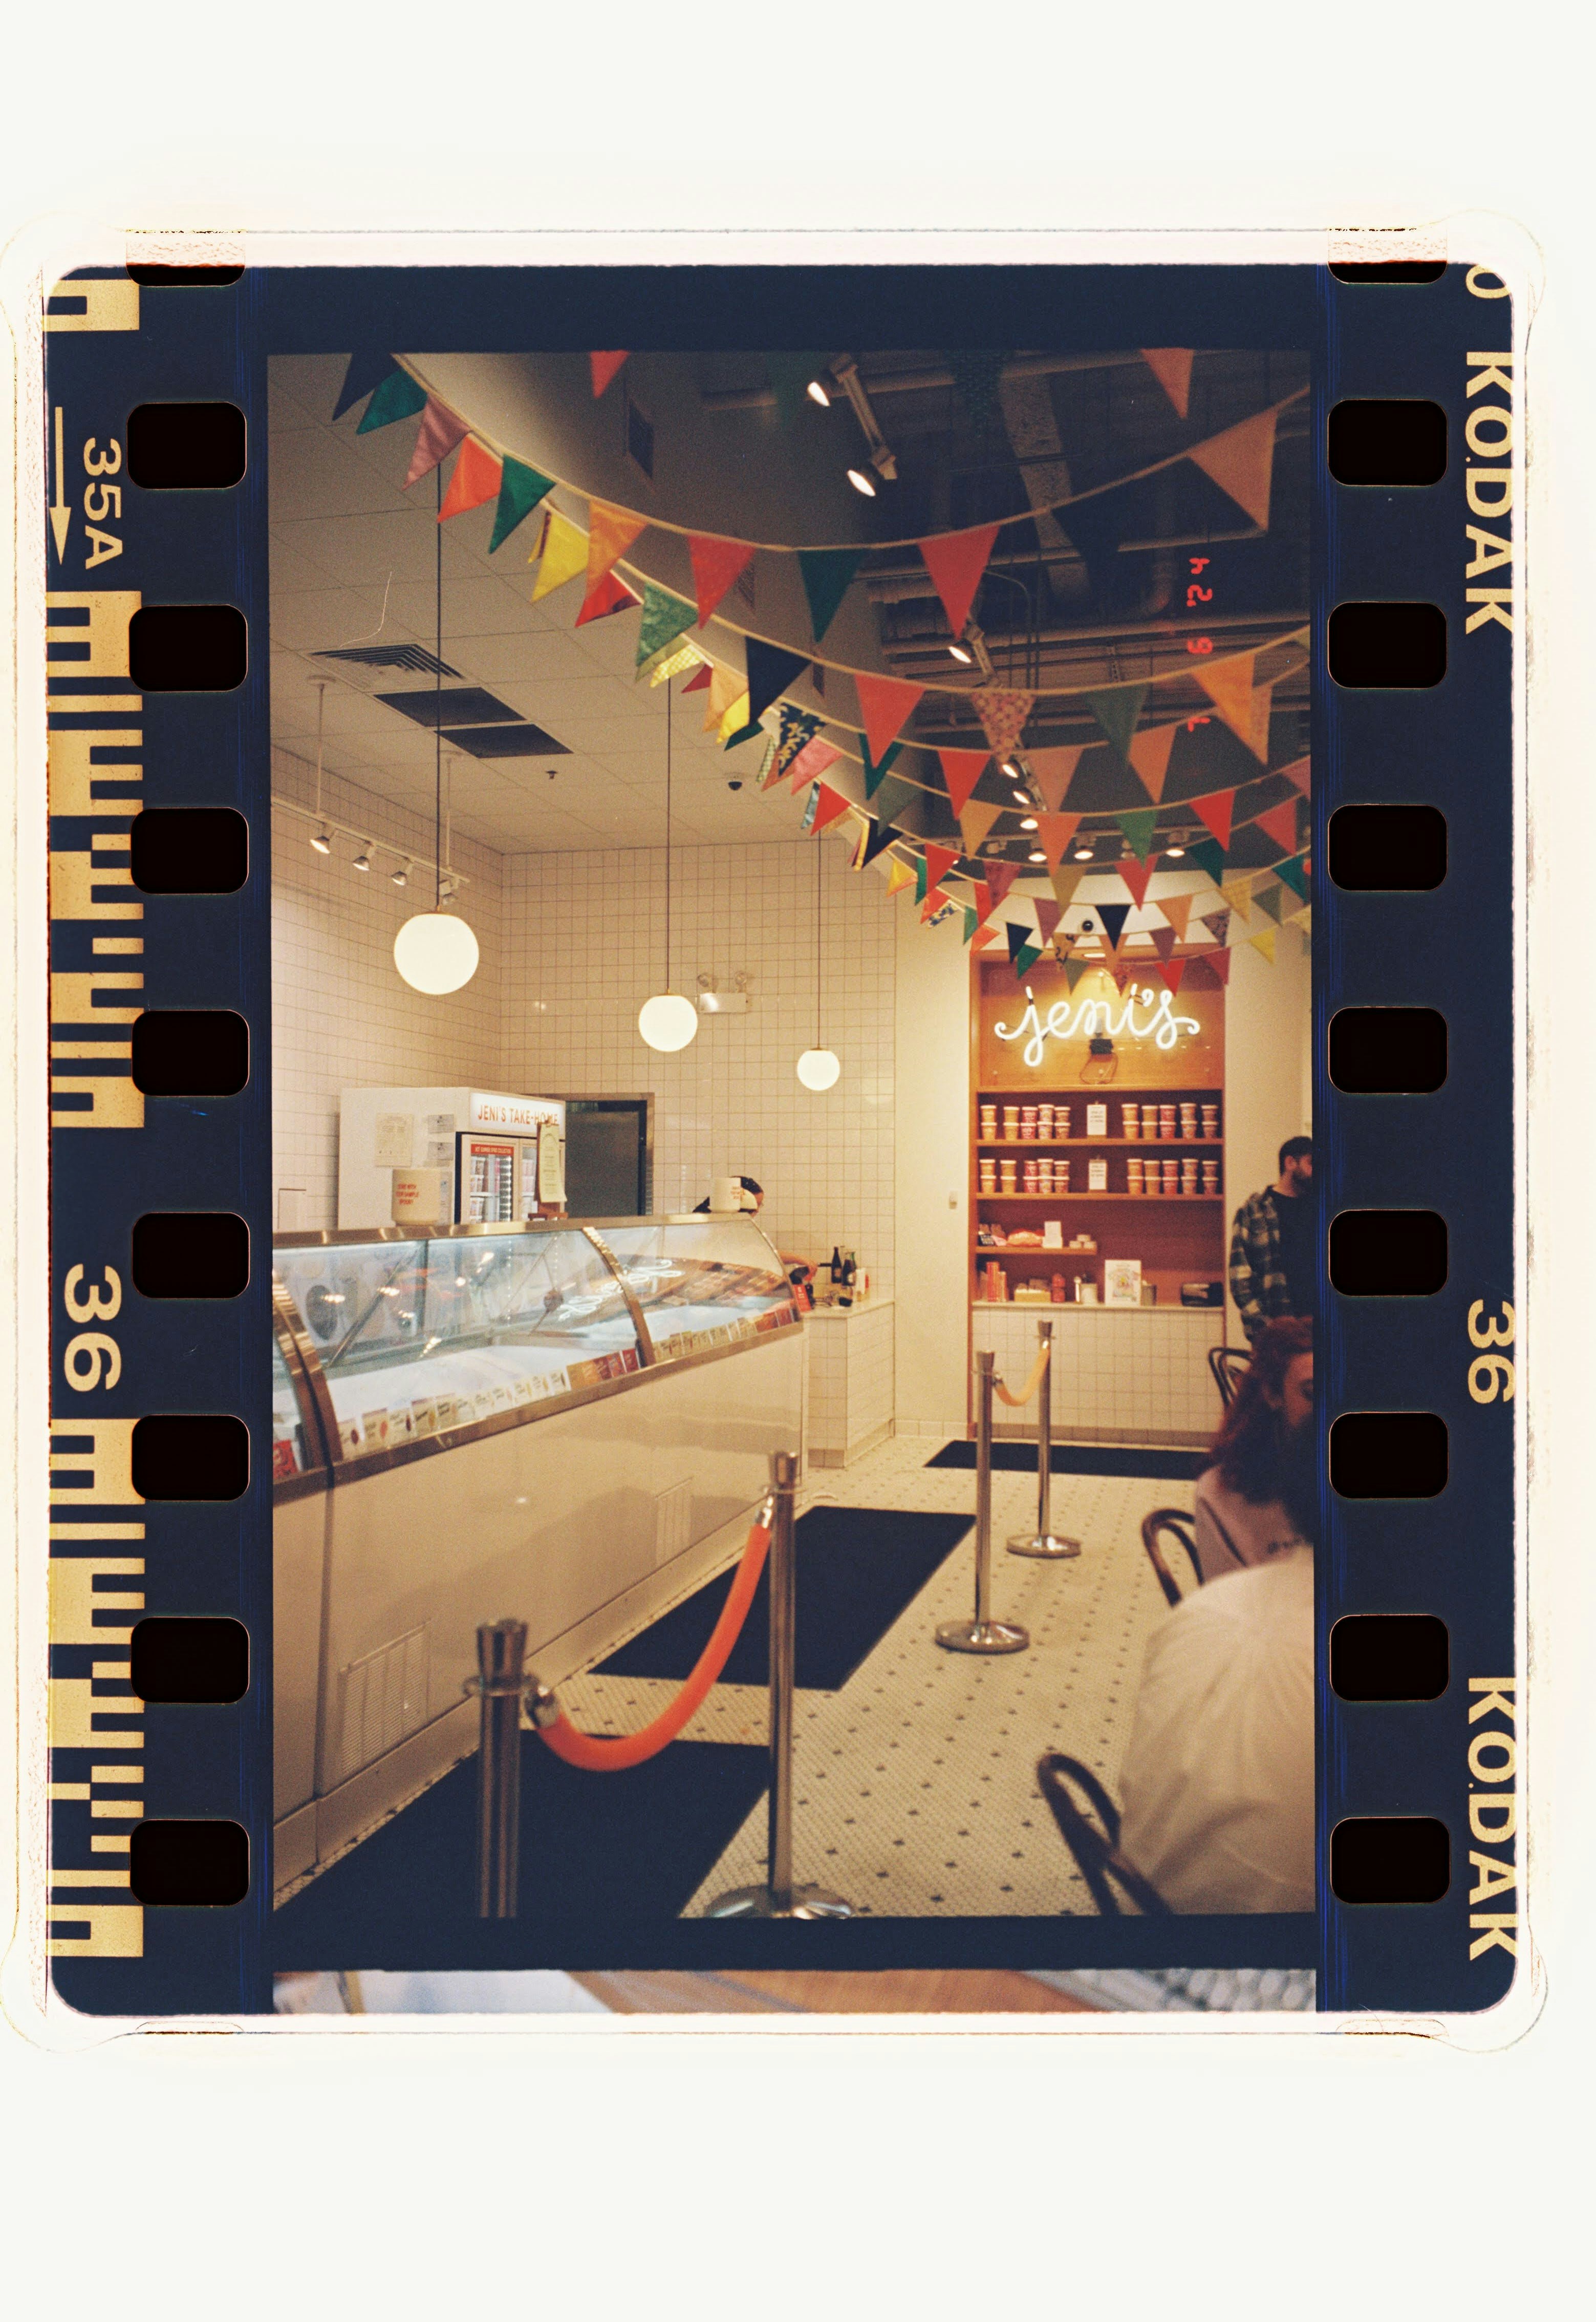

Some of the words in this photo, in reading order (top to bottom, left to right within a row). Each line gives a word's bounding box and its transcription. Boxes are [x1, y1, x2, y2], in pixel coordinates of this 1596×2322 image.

[83, 437, 123, 569] 35A
[1465, 351, 1514, 634] KODAK
[994, 983, 1201, 1067] jeni's
[478, 1104, 507, 1122] JENI'S
[64, 1263, 122, 1392] 36
[1468, 1298, 1516, 1404] 36
[1468, 1677, 1519, 1961] KODAK
